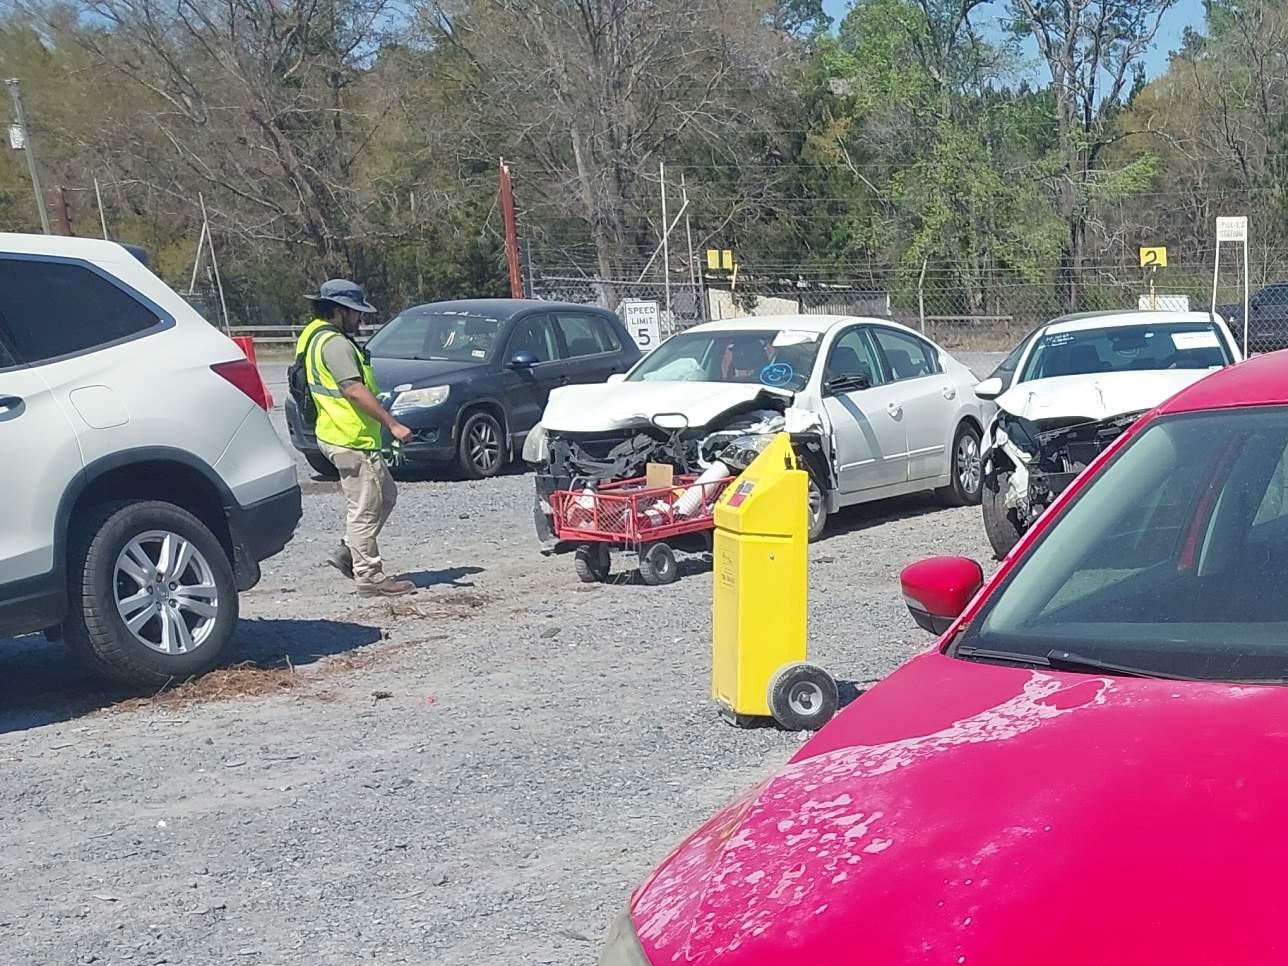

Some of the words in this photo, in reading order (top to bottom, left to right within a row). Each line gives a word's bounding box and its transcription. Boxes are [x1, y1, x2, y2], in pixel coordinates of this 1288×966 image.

[1143, 249, 1162, 267] 2
[627, 306, 656, 315] SPEED
[631, 317, 654, 326] LIMIT
[637, 328, 651, 346] 5
